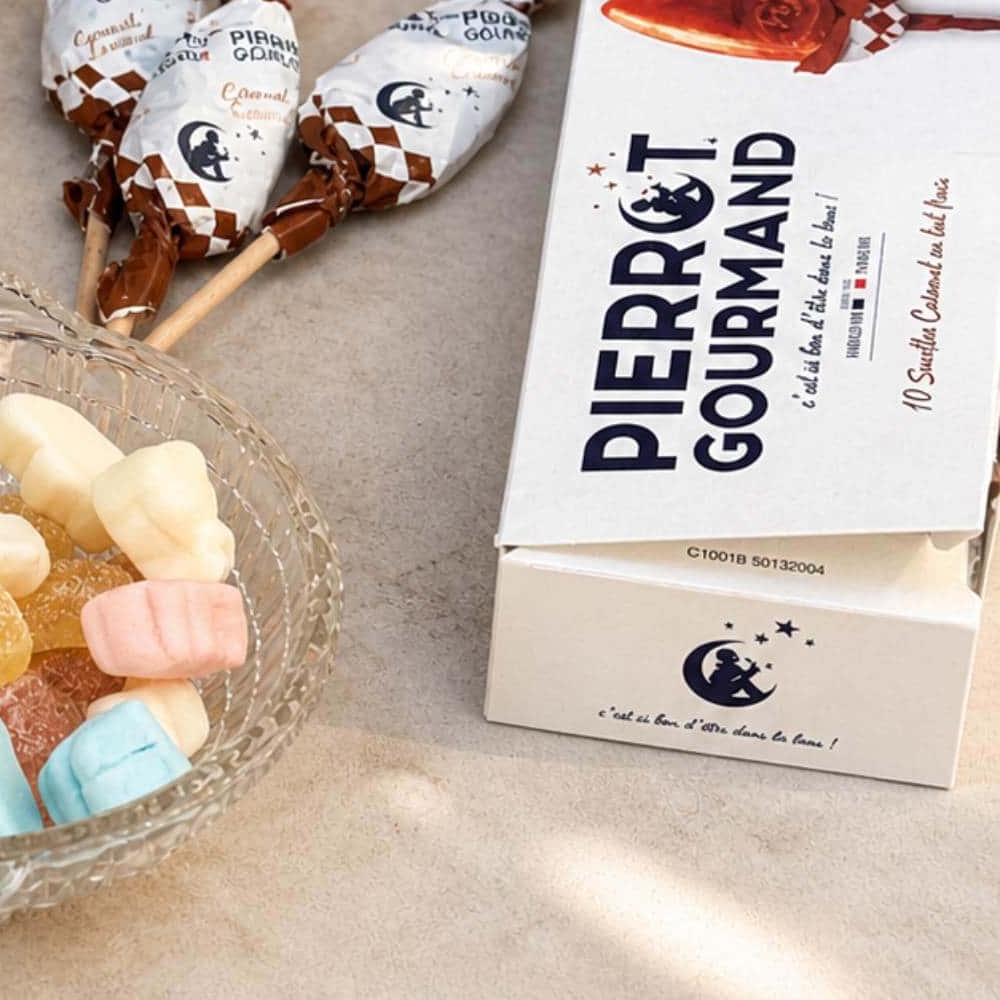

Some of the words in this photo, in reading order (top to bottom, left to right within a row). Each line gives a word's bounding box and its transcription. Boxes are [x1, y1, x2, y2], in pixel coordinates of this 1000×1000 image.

[581, 133, 718, 473] PIERROT
[692, 131, 797, 473] GOURMAND
[901, 388, 933, 413] 10
[751, 556, 825, 575] 50132004
